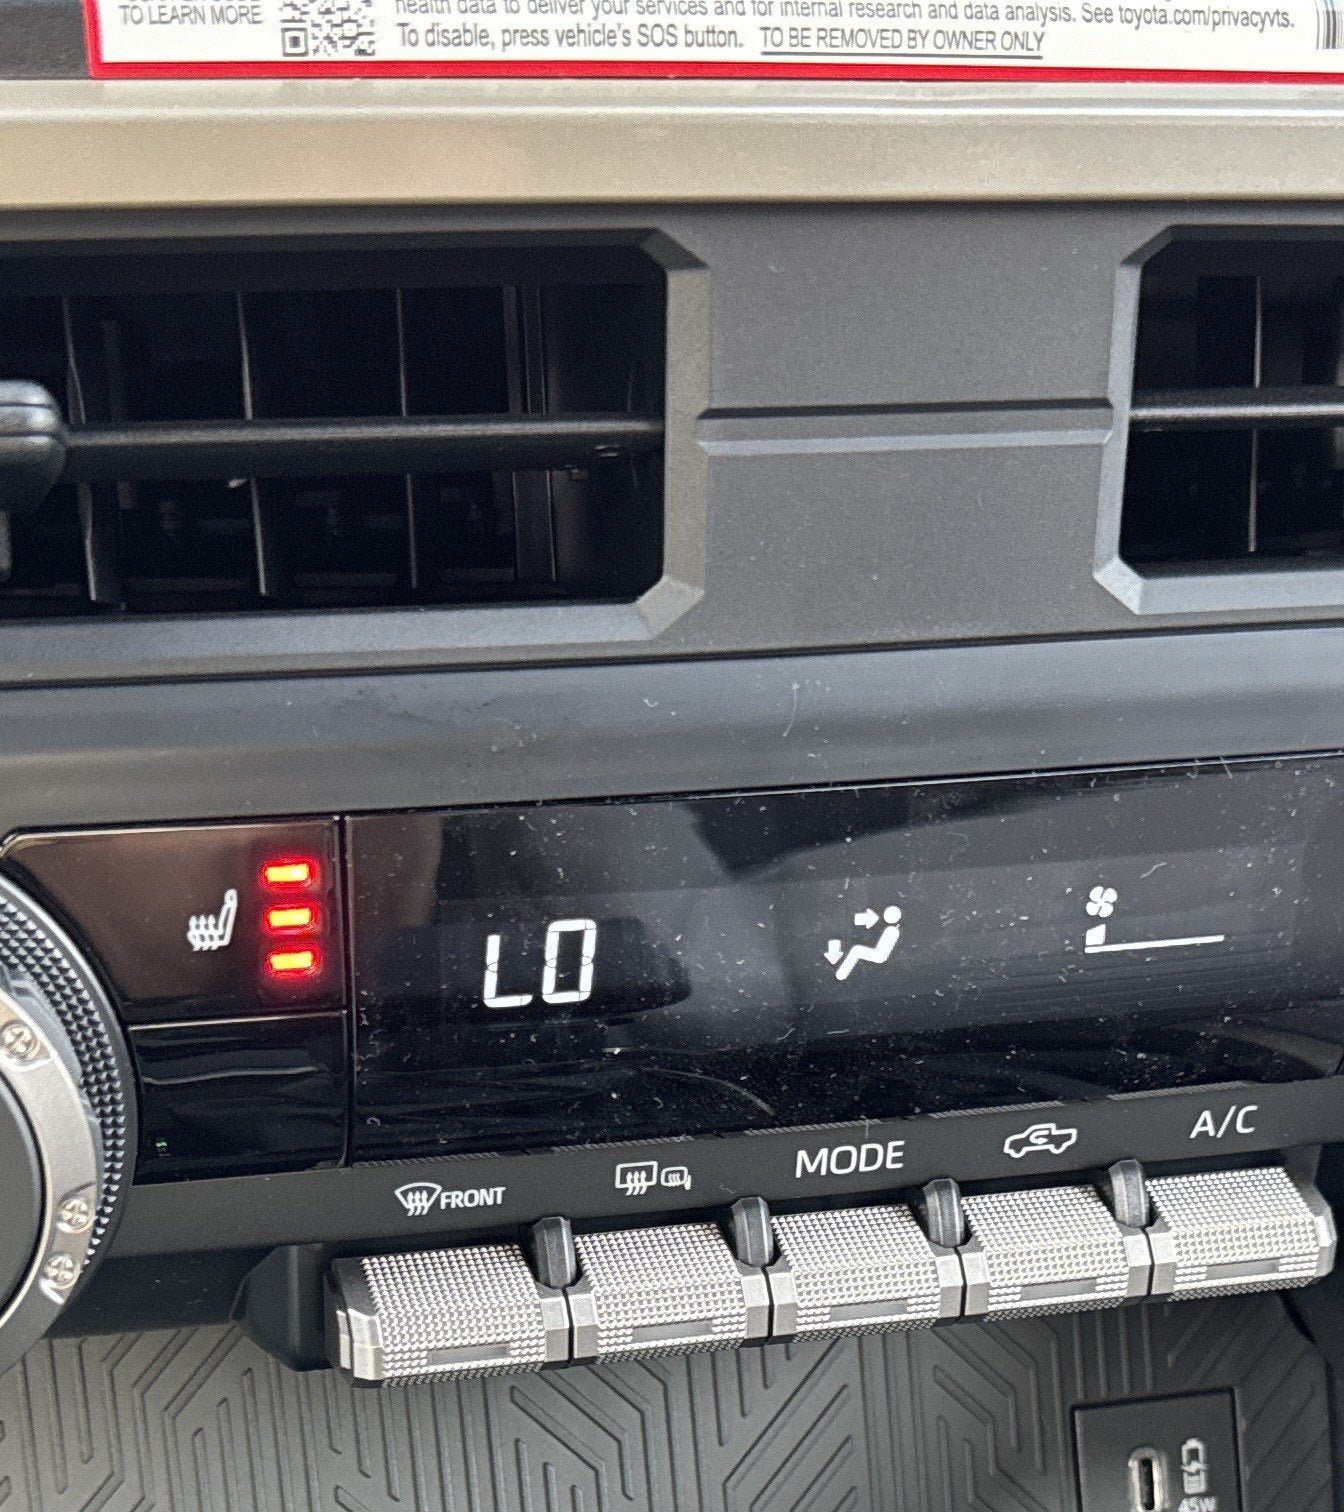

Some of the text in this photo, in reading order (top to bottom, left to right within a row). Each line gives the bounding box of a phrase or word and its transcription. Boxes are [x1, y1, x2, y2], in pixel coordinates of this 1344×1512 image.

[118, 5, 263, 25] TO LEARN MORE
[458, 0, 497, 15] data
[504, 0, 521, 15] to
[527, 0, 585, 16] deliver
[592, 0, 629, 21] your
[636, 0, 708, 16] services
[714, 0, 746, 17] and
[752, 0, 773, 17] for
[780, 0, 843, 18] internal
[849, 0, 923, 19] research
[928, 0, 959, 20] and
[964, 0, 1000, 21] data
[1005, 2, 1077, 28] analysis.
[1082, 3, 1114, 25] See
[1118, 4, 1296, 34] toyota.com/privacyvts.
[396, 22, 1046, 52] To disable, press vehicle's SOS button. TO BE REMOVED BY OWNER ONLY
[1189, 1105, 1258, 1140] A/C
[795, 1140, 906, 1178] MODE
[439, 1185, 506, 1210] FRONT
